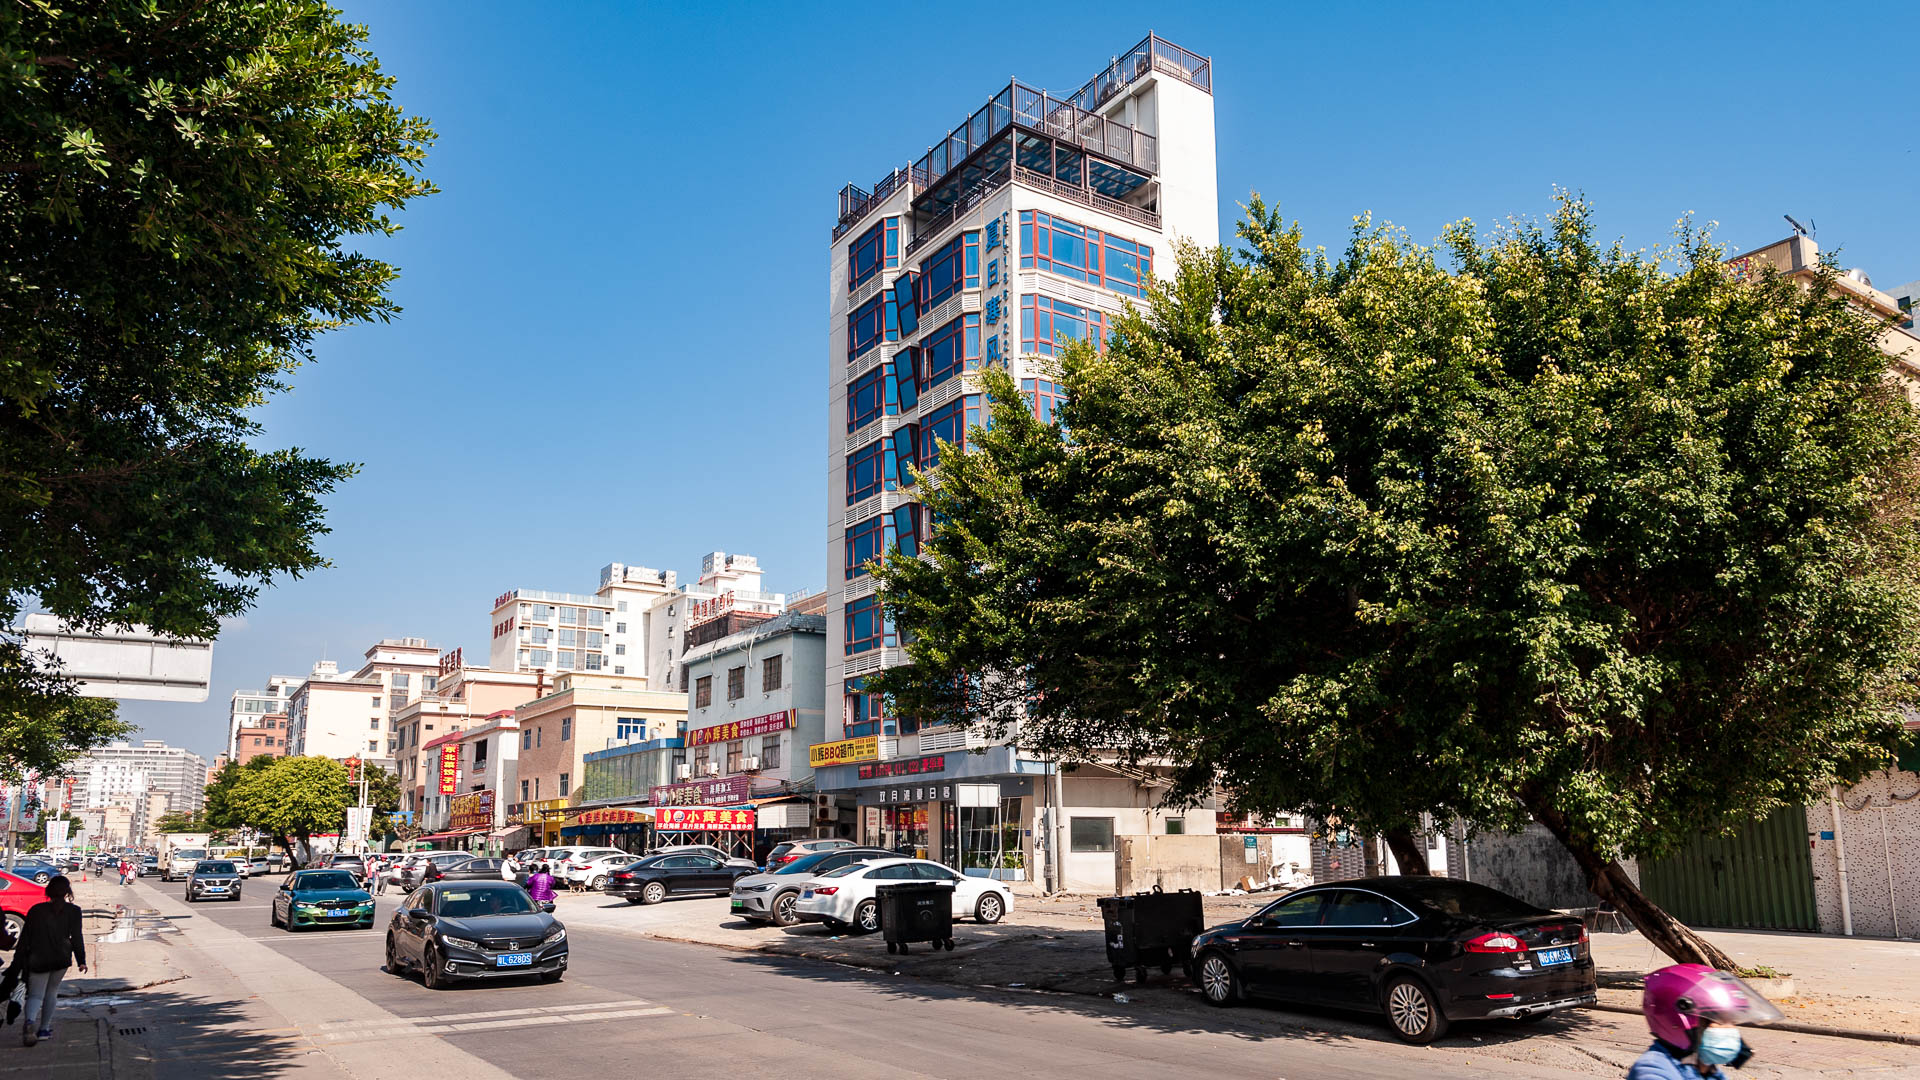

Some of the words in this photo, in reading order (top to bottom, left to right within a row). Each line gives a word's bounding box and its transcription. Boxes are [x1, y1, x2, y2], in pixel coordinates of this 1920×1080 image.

[704, 722, 739, 743] 小辉美食
[810, 743, 855, 762] 小辉BBQ超市
[667, 785, 702, 806] 小辉美食
[686, 810, 748, 823] 小辉美食
